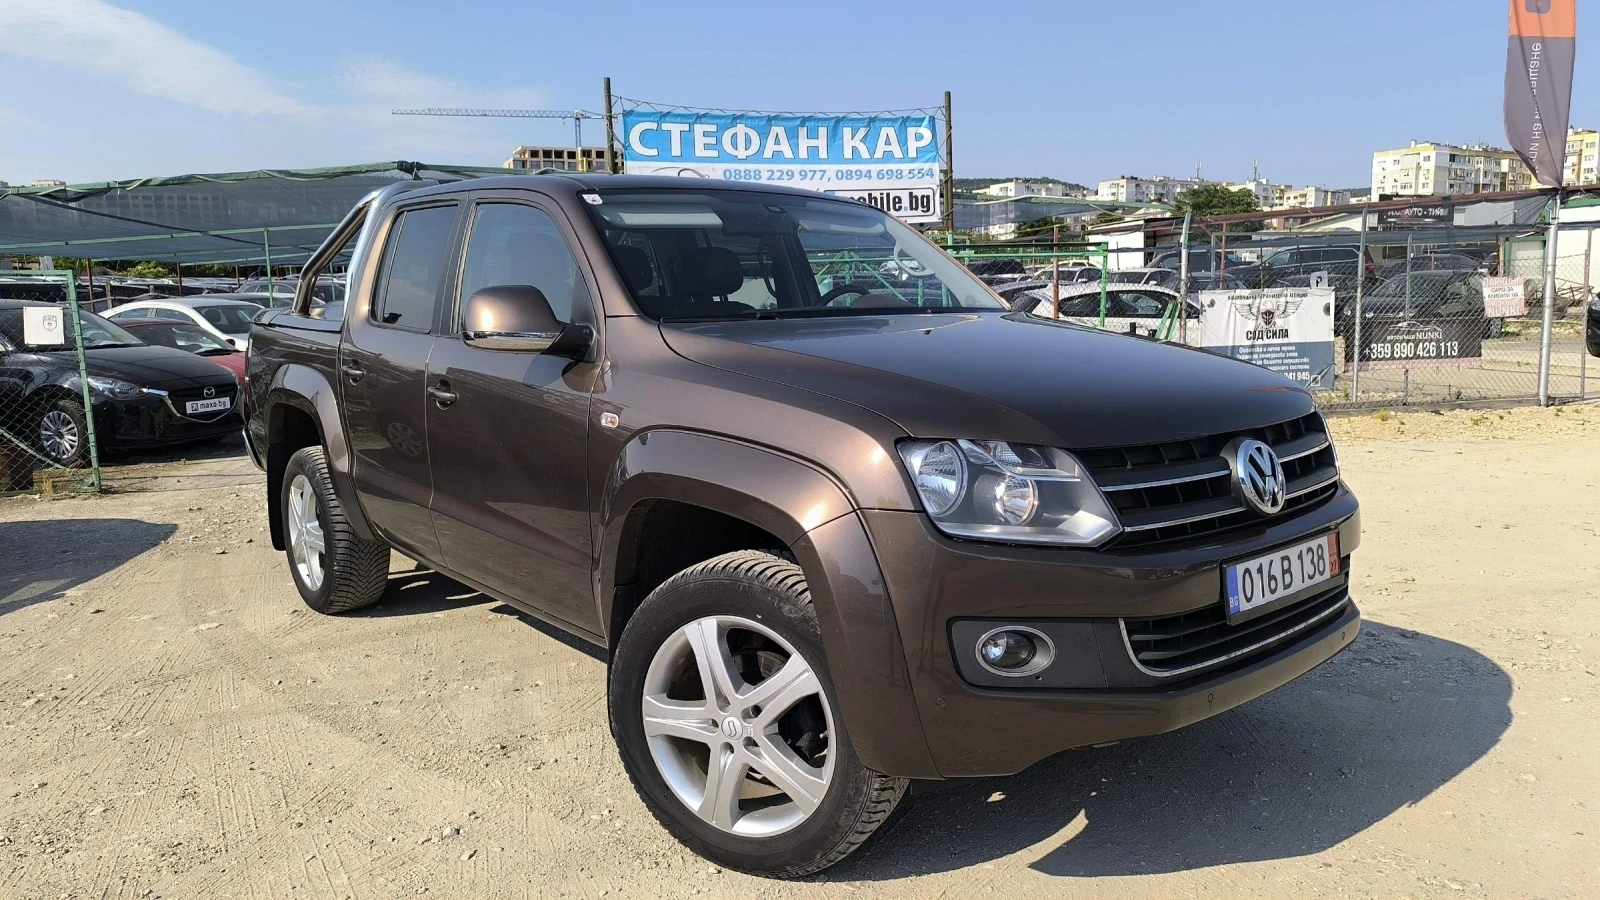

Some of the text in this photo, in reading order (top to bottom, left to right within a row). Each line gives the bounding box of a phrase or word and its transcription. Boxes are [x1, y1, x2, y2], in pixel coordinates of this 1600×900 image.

[628, 121, 935, 161] СТЕФАН КАР
[723, 167, 935, 183] 0888 229 977, 0894 698 554
[850, 191, 931, 214] bile.bg
[1265, 328, 1289, 340] СИЛА
[1415, 331, 1443, 339] NUNKI
[1363, 341, 1459, 358] +359 890 426 113
[1296, 371, 1310, 380] 945
[1229, 595, 1239, 608] BG
